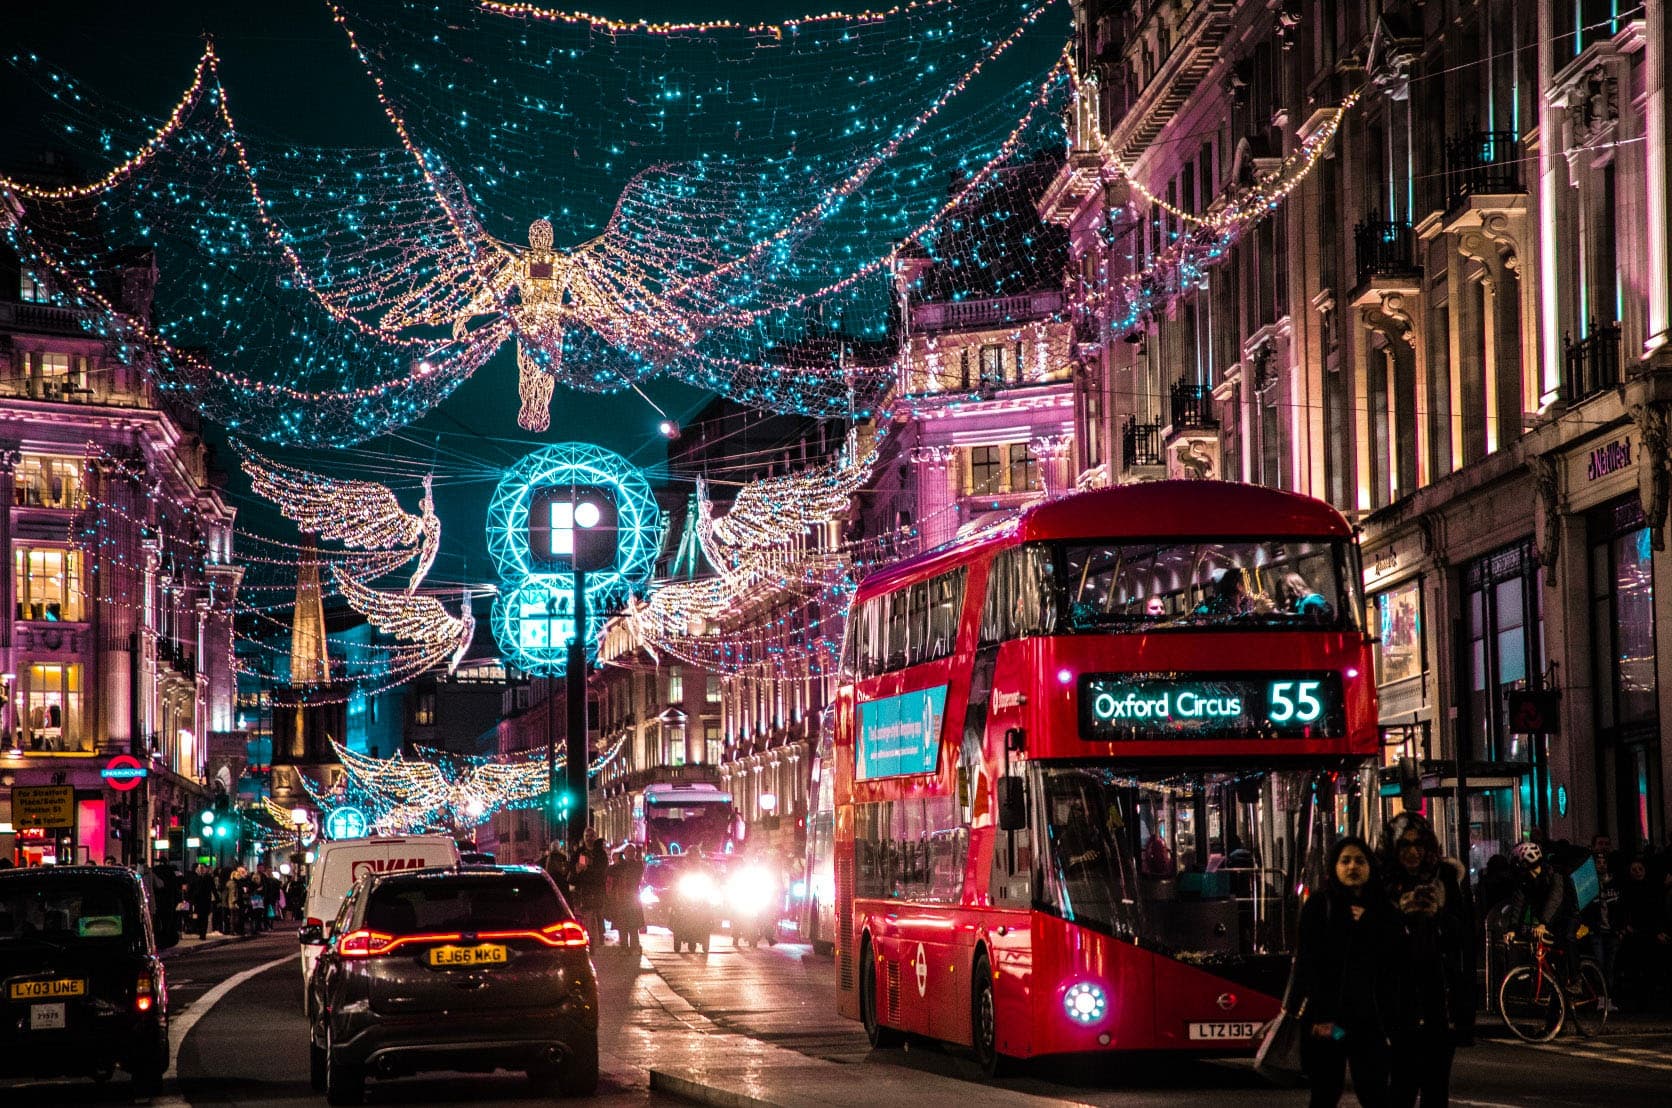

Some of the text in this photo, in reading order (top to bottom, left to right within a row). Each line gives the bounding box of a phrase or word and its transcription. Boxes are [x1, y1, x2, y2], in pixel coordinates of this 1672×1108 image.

[1095, 682, 1321, 721] Oxford Circus 55
[436, 948, 501, 963] EJ66 MKG
[15, 981, 79, 996] LY03 UNE
[1199, 1023, 1253, 1038] LTZ 1313
